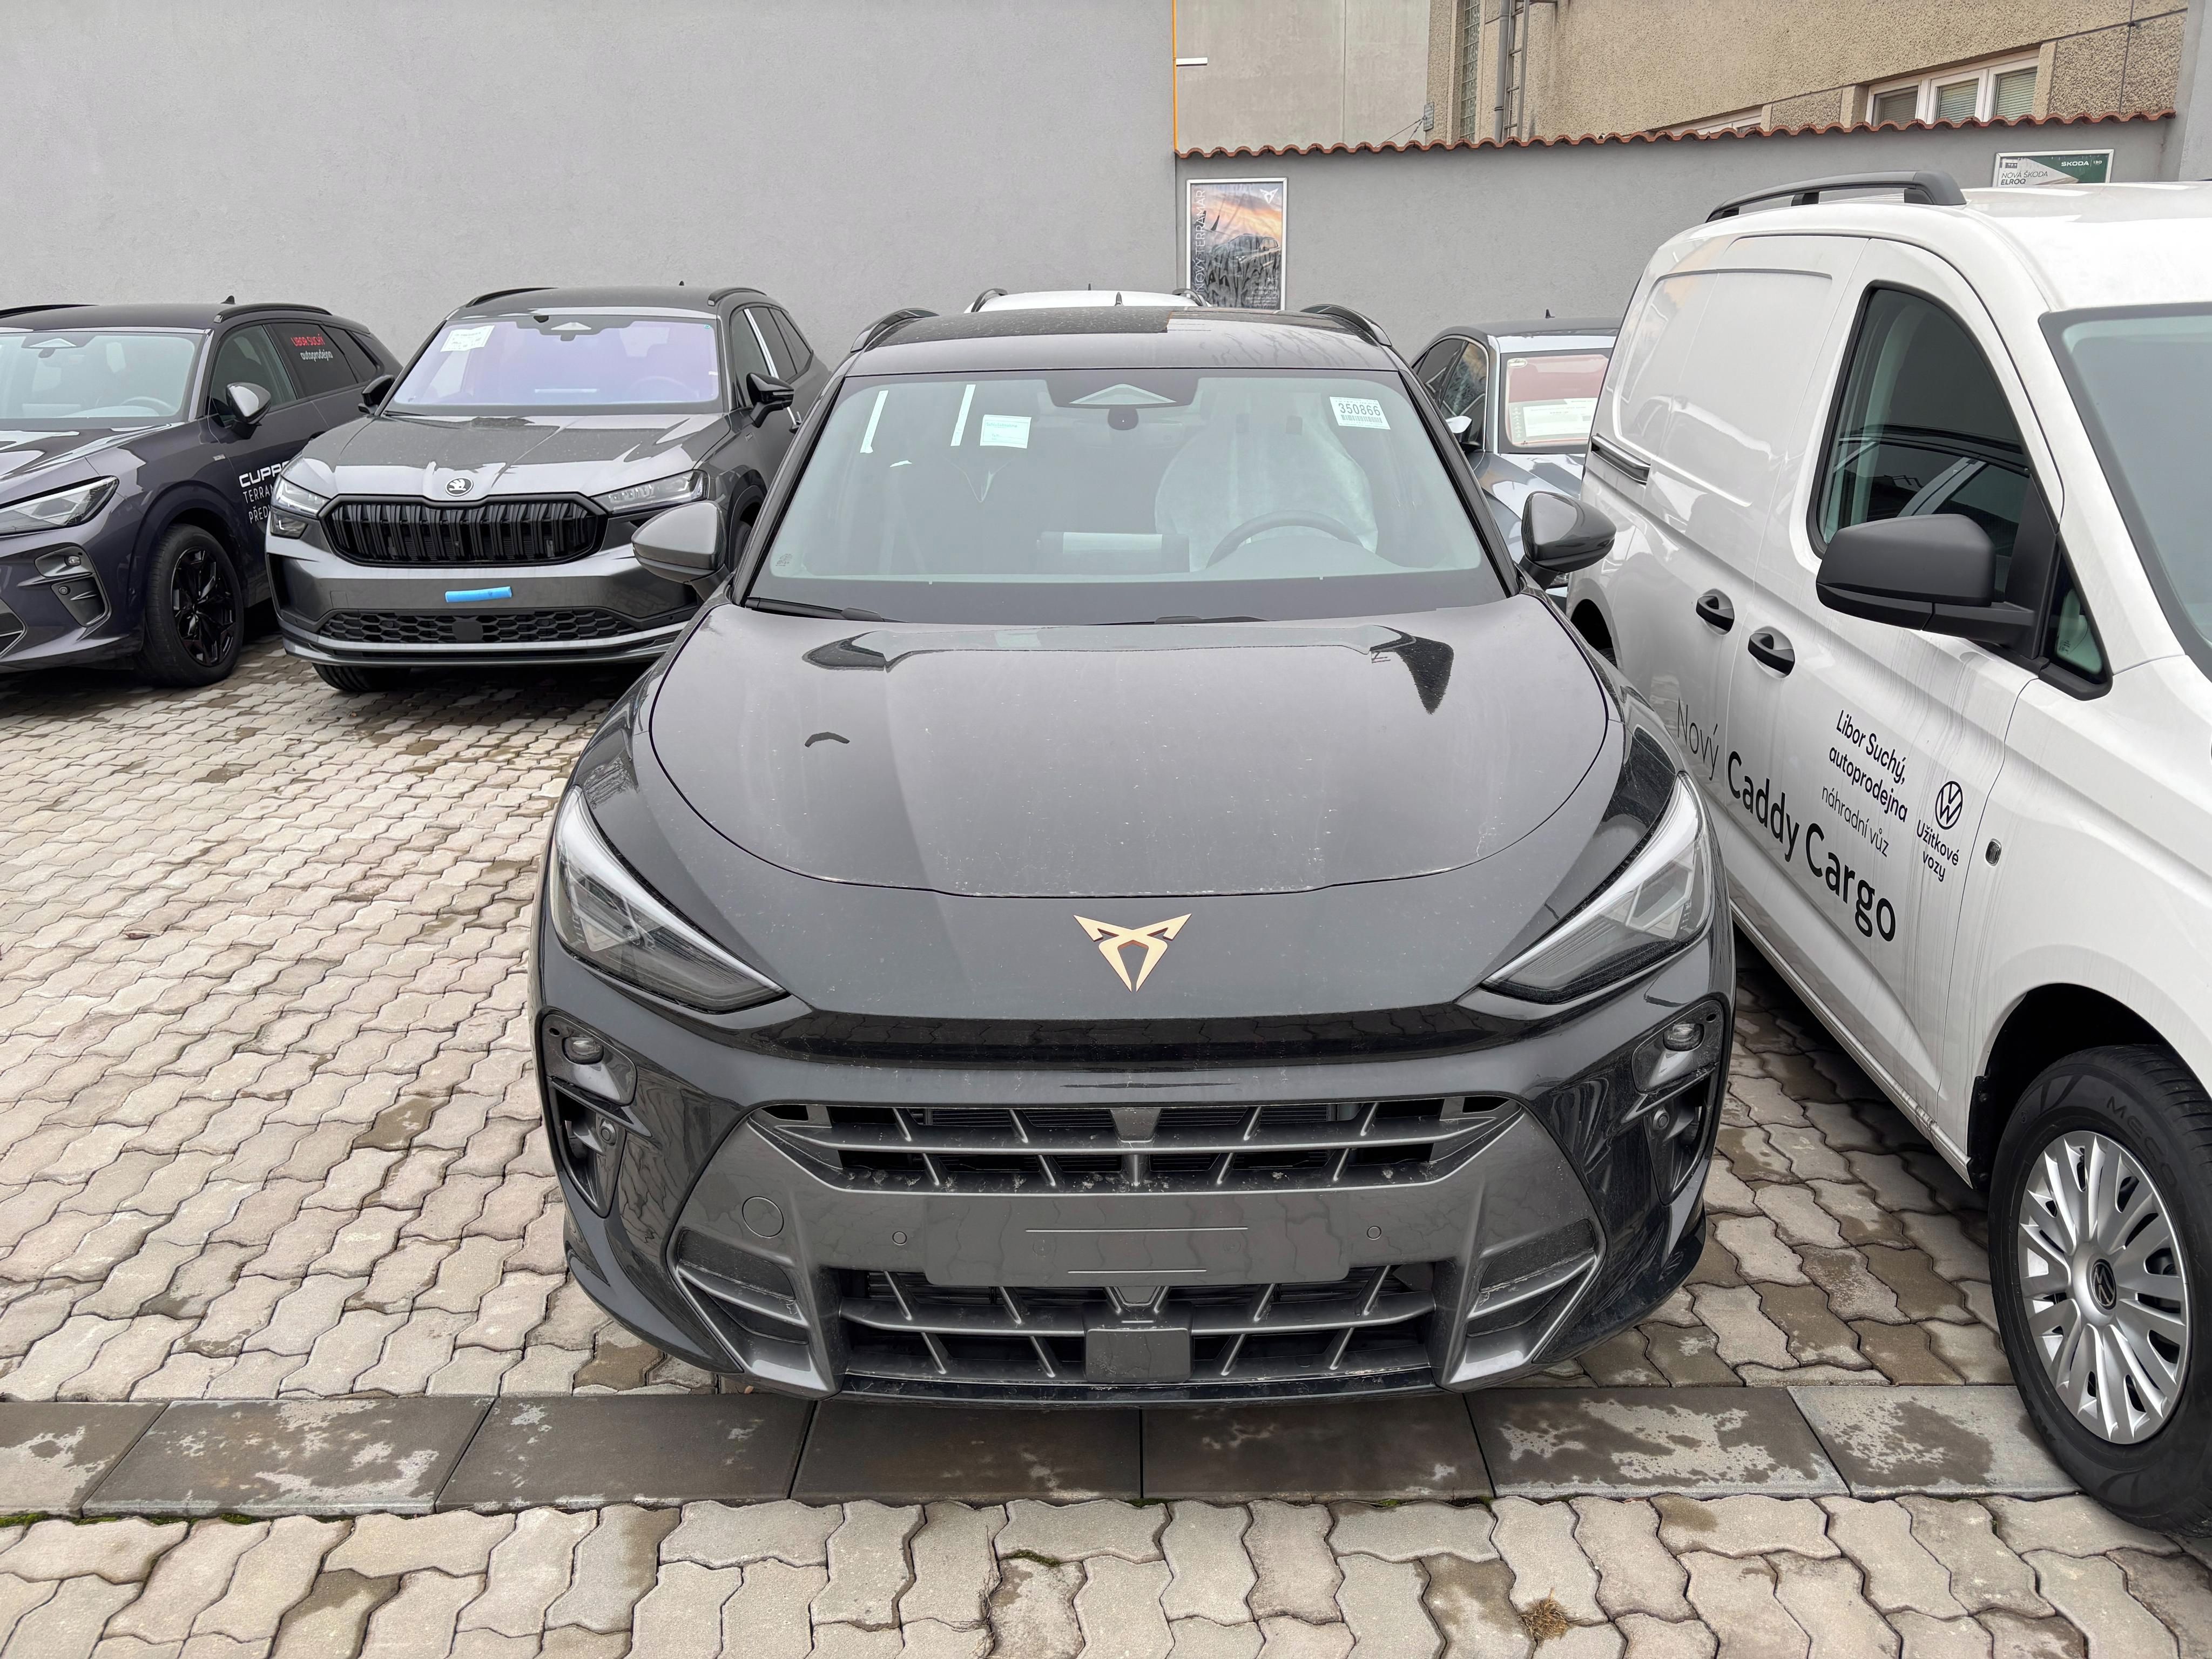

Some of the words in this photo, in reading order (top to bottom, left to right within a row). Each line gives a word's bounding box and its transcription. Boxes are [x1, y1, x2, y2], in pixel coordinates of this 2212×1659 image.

[2001, 170, 2022, 179] NOVÁ
[1195, 190, 1206, 255] TERRAMAR
[1338, 403, 1380, 416] 350866
[248, 504, 271, 524] PŘED
[1836, 710, 1866, 748] Libor
[1866, 733, 1906, 785] Suchý,
[1829, 747, 1908, 822] autoprodejna
[1677, 697, 1719, 781] Nový
[1728, 751, 1800, 862] Caddy
[1806, 823, 1896, 942] Cargo
[1822, 786, 1869, 839] náhradní
[1870, 827, 1889, 858] vůz
[1917, 819, 1960, 866] Užitkové
[1923, 851, 1946, 882] vozy
